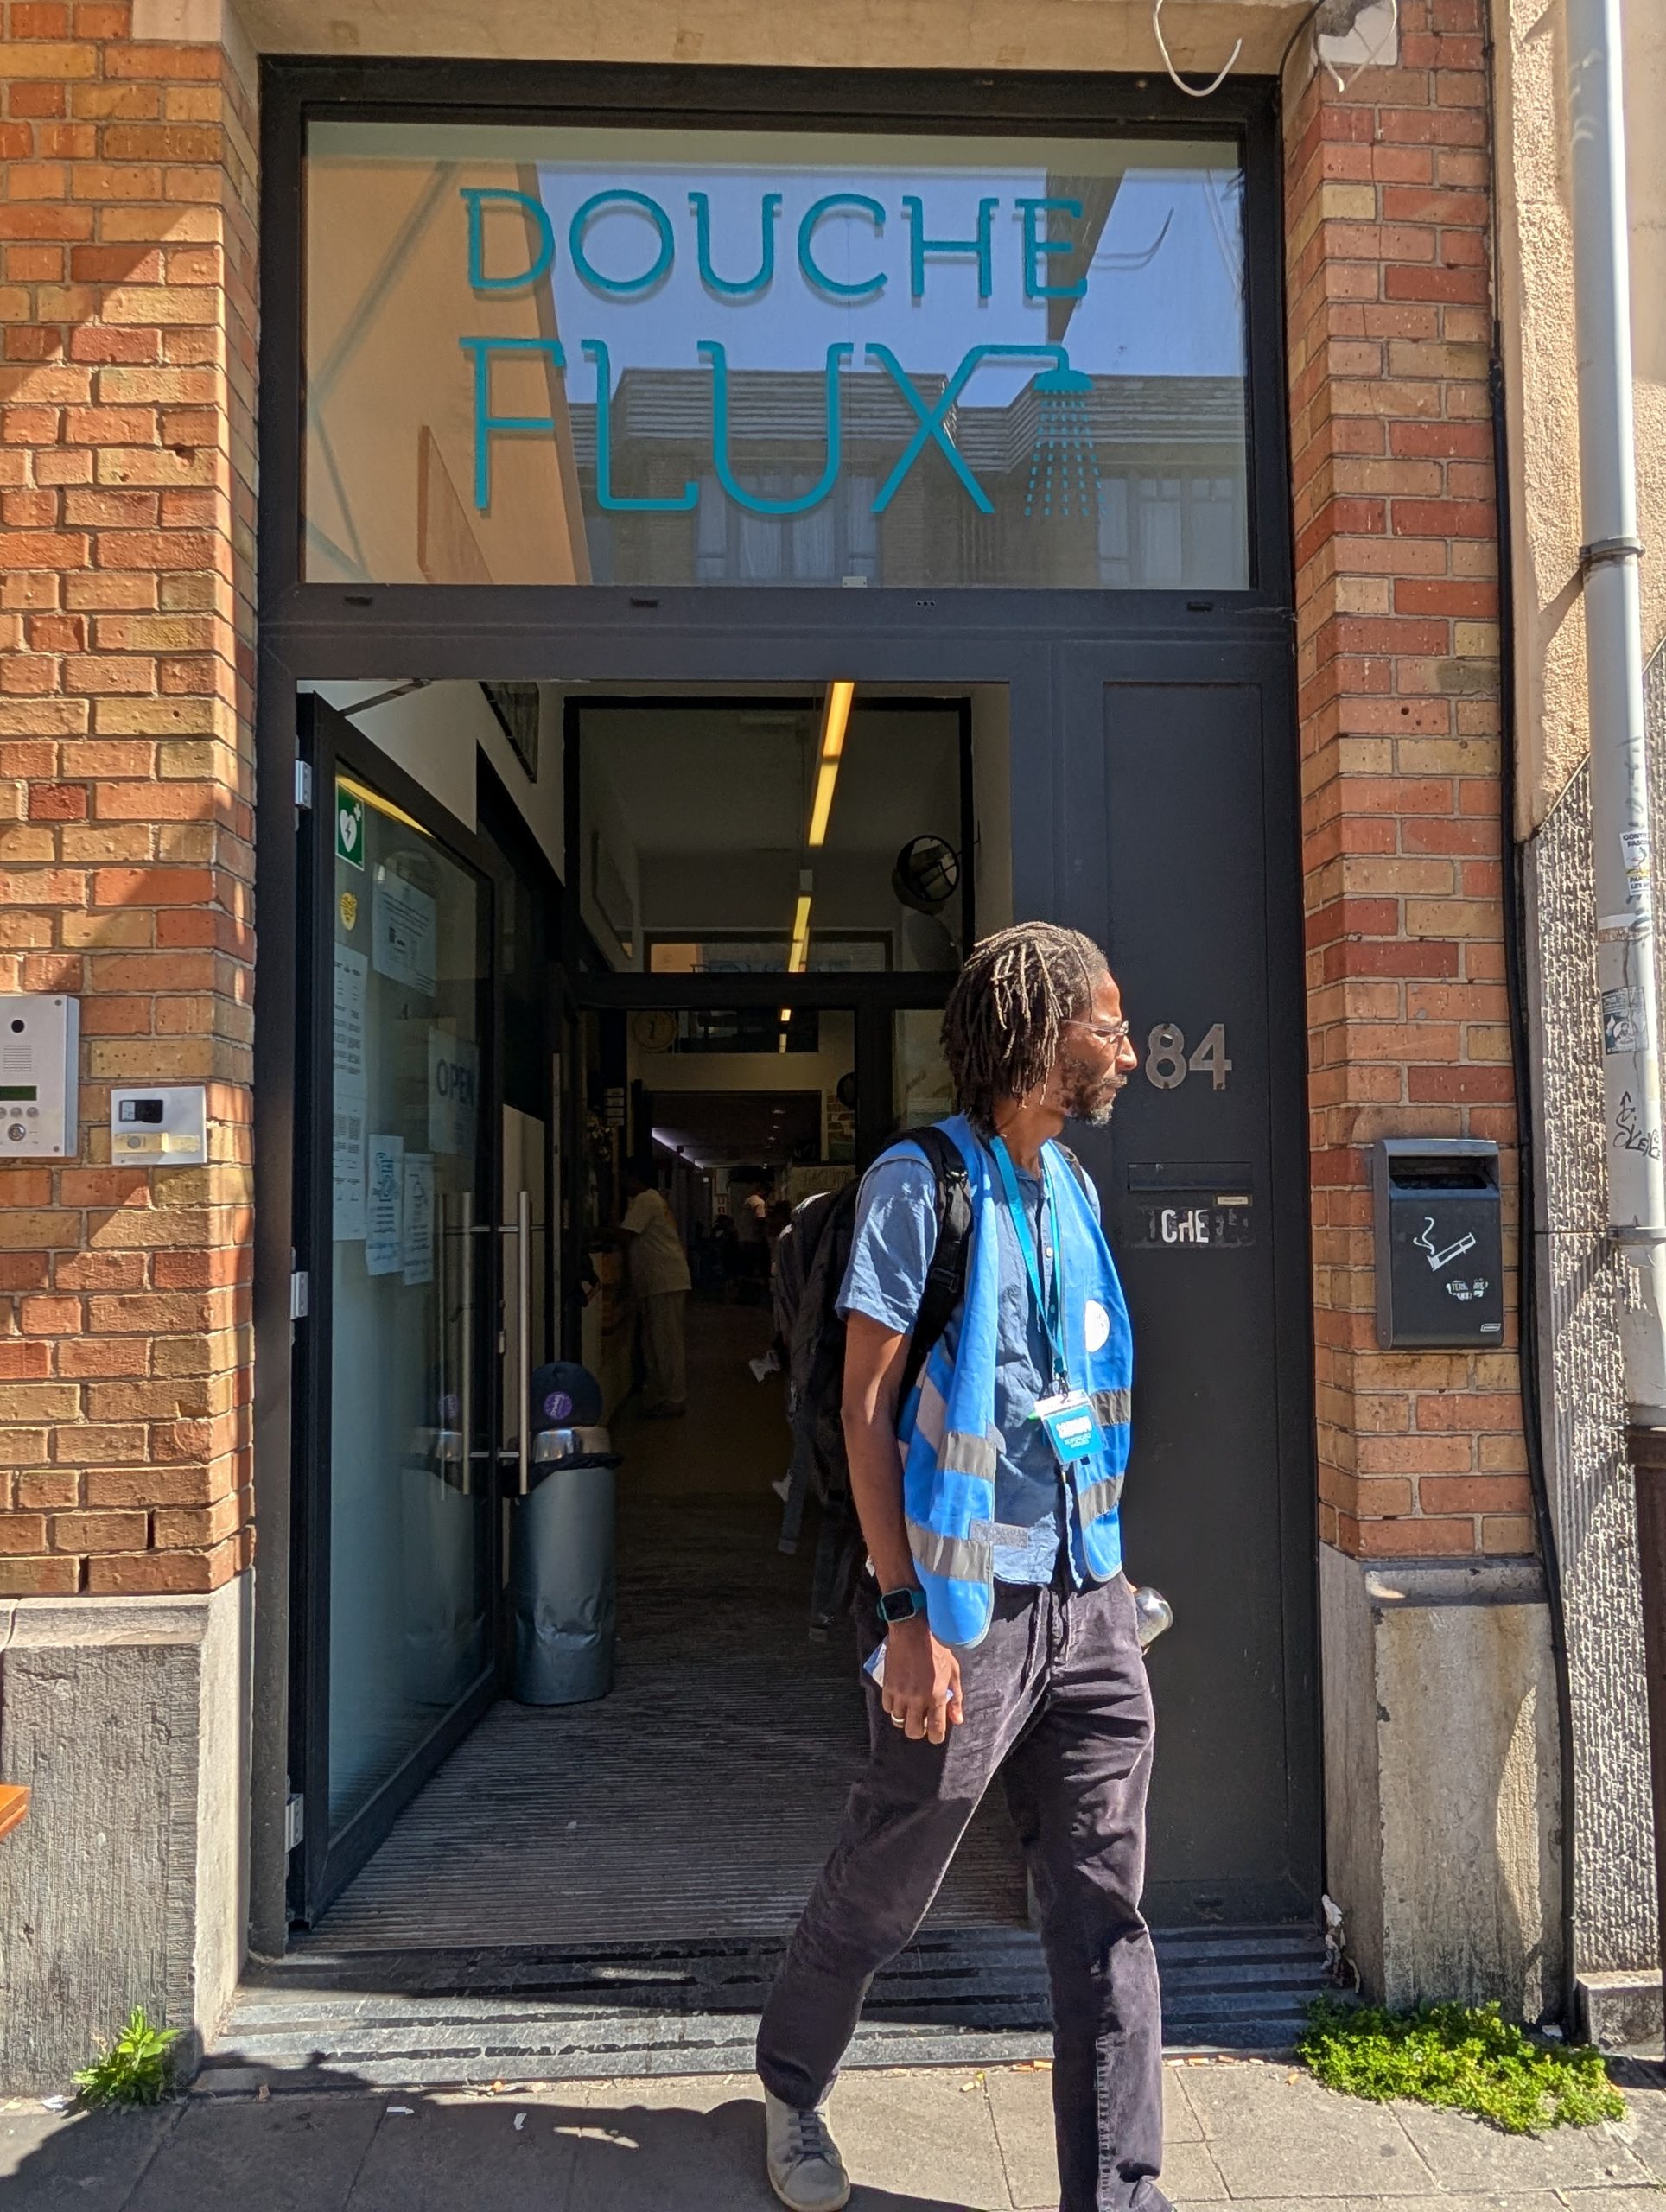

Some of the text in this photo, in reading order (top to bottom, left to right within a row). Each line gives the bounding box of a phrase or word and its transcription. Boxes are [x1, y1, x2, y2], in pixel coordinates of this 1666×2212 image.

[460, 188, 1087, 298] DOUCHE
[460, 338, 995, 514] FLUX
[436, 1058, 475, 1107] OPEN
[1145, 1023, 1232, 1090] 84
